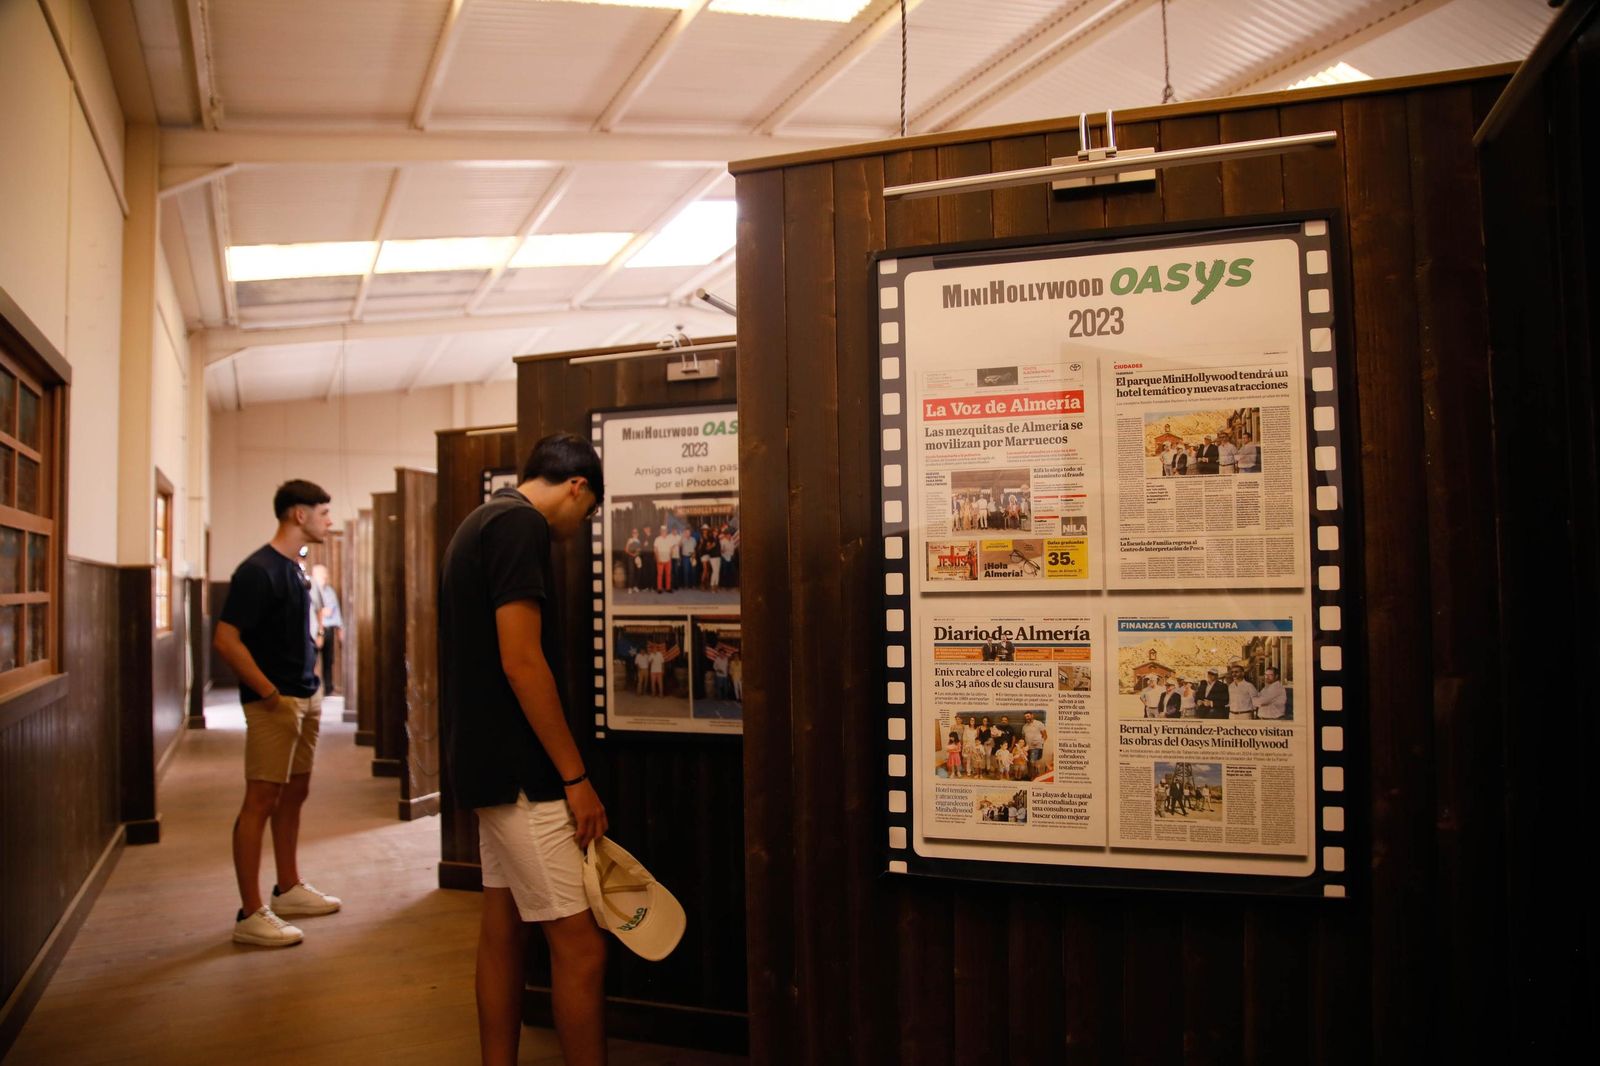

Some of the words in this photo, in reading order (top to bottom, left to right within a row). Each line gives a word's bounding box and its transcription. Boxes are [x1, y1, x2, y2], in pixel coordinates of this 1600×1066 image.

[1068, 306, 1125, 338] 2023
[1116, 377, 1126, 386] El
[1127, 377, 1162, 388] parque
[1162, 371, 1238, 384] MiniHollywood
[1239, 370, 1273, 380] tendrá
[1116, 388, 1141, 398] hotel
[1142, 385, 1186, 396] temático
[1194, 385, 1228, 394] nuevas
[1230, 381, 1288, 392] atracciones
[926, 403, 946, 417] La
[950, 401, 981, 416] Voz
[985, 400, 1006, 414] de
[1010, 395, 1081, 412] Almería
[925, 427, 944, 438] Las
[945, 424, 1005, 438] mezquitas
[1006, 422, 1020, 434] de
[1022, 420, 1069, 432] Almería
[1071, 421, 1083, 430] se
[925, 438, 981, 450] movilizan
[983, 440, 1003, 450] por
[1005, 434, 1068, 447] Marruecos
[682, 442, 708, 458] 2023
[634, 466, 672, 476] Amigos
[675, 466, 694, 476] que
[697, 463, 716, 472] han
[656, 481, 672, 490] por
[675, 479, 684, 487] el
[686, 477, 736, 488] Photocall
[1063, 524, 1088, 533] NILA
[934, 626, 989, 641] Diario
[992, 626, 1013, 641] de
[1015, 626, 1090, 641] Almería
[935, 668, 954, 677] Enix
[956, 668, 984, 677] reabre
[986, 668, 994, 677] el
[996, 668, 1028, 679] colegio
[1029, 668, 1052, 678] rural
[942, 679, 954, 688] los
[956, 680, 967, 688] 34
[968, 679, 990, 688] años
[991, 679, 1002, 688] de
[1015, 680, 1054, 689] clausura
[1120, 724, 1151, 734] Bernal
[1154, 727, 1160, 736] y
[1161, 724, 1258, 736] Fernández-Pacheco
[1259, 727, 1294, 737] visitan
[1120, 735, 1134, 746] las
[1135, 736, 1162, 746] obras
[1164, 736, 1179, 747] del
[1180, 738, 1210, 749] Oasys
[1211, 738, 1288, 750] MiniHollywood
